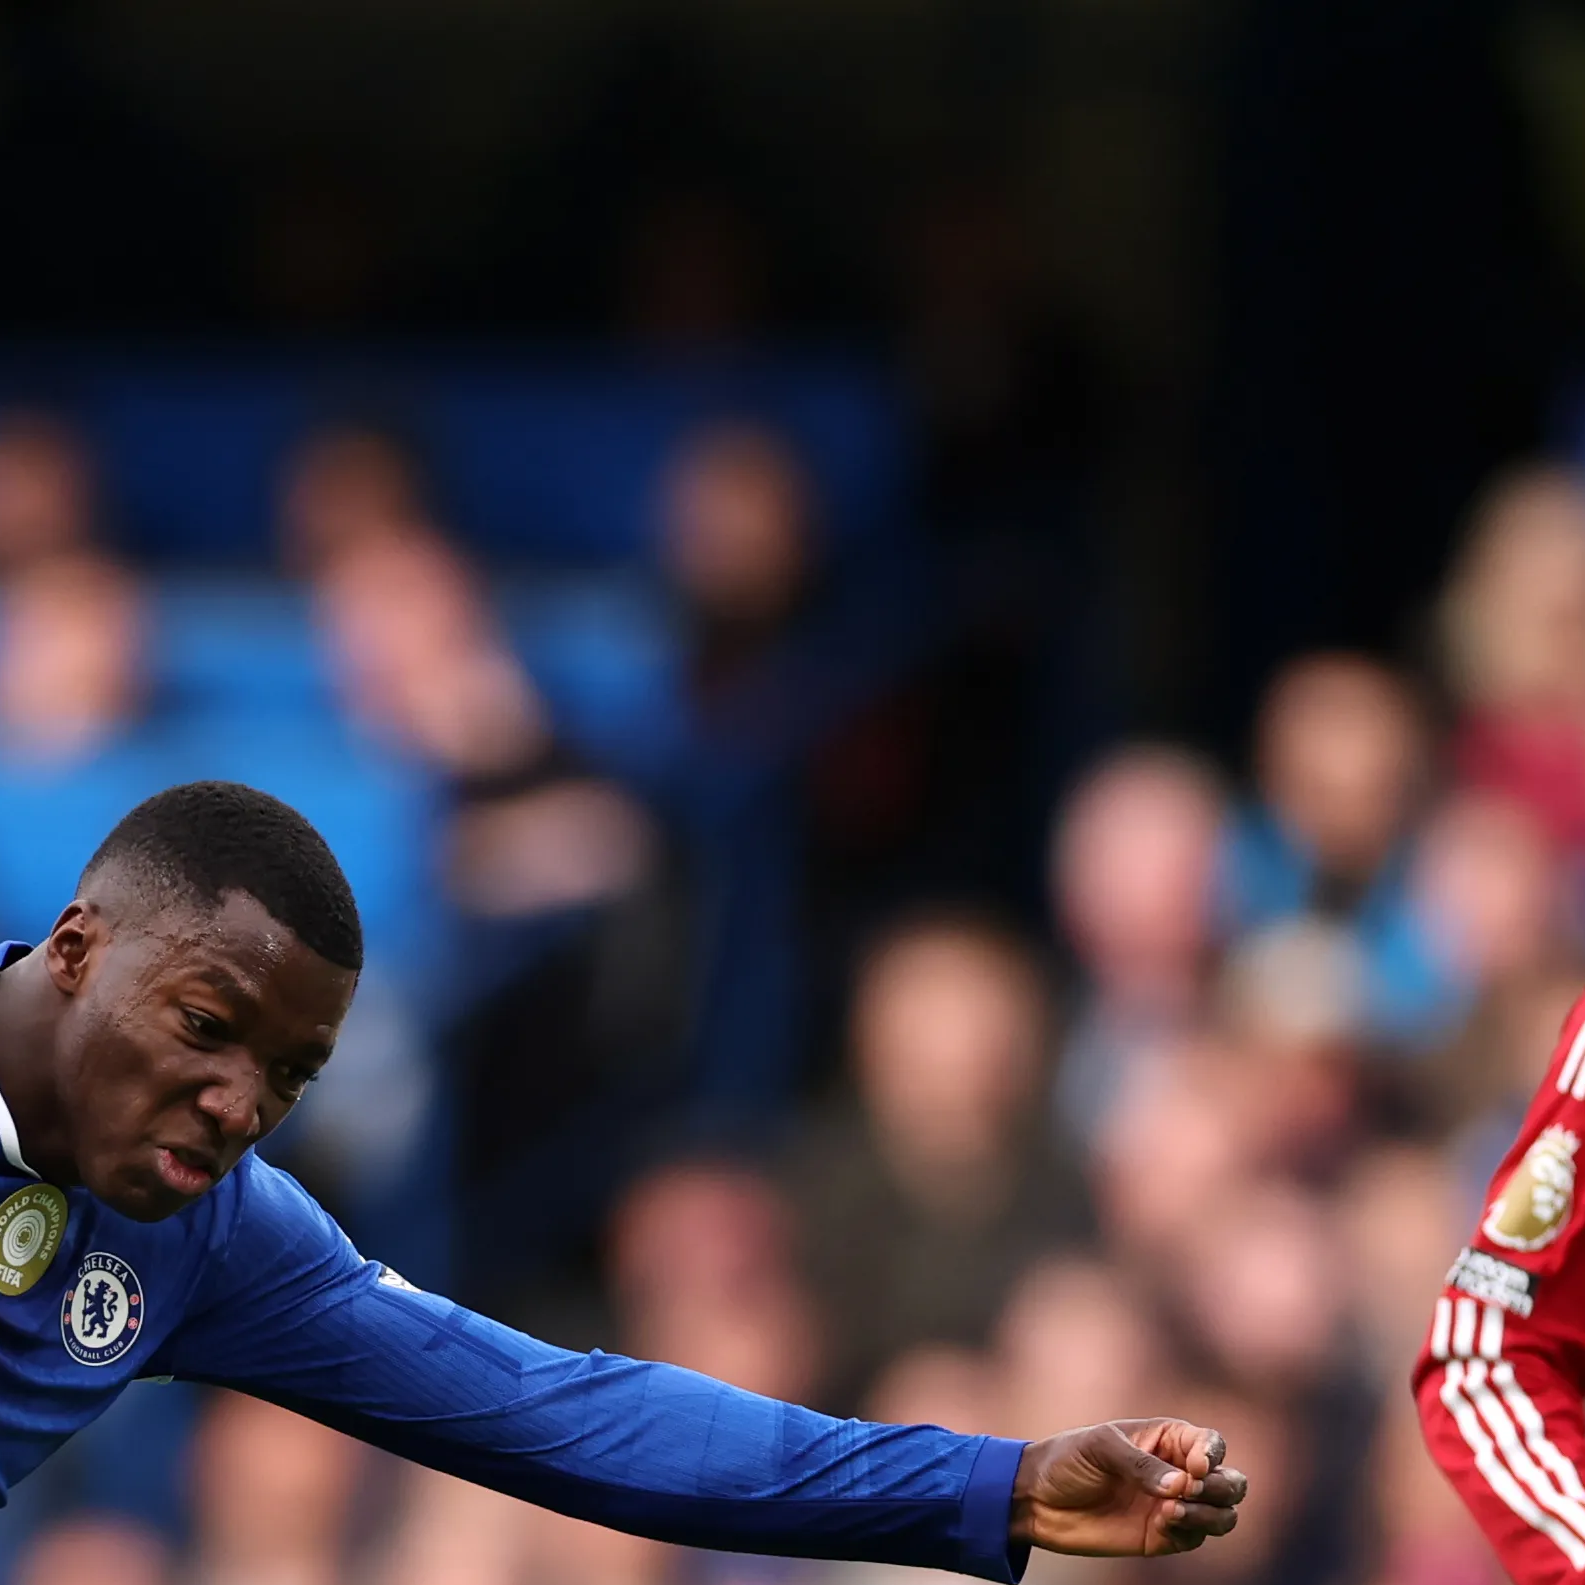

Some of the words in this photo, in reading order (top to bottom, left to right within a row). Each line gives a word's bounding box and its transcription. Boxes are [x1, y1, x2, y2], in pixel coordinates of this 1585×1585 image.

[33, 1193, 61, 1260] CHAMPIONS
[77, 1256, 128, 1283] CHELSEA
[68, 1338, 101, 1359] FOOTBALL
[104, 1340, 125, 1357] CLUB
